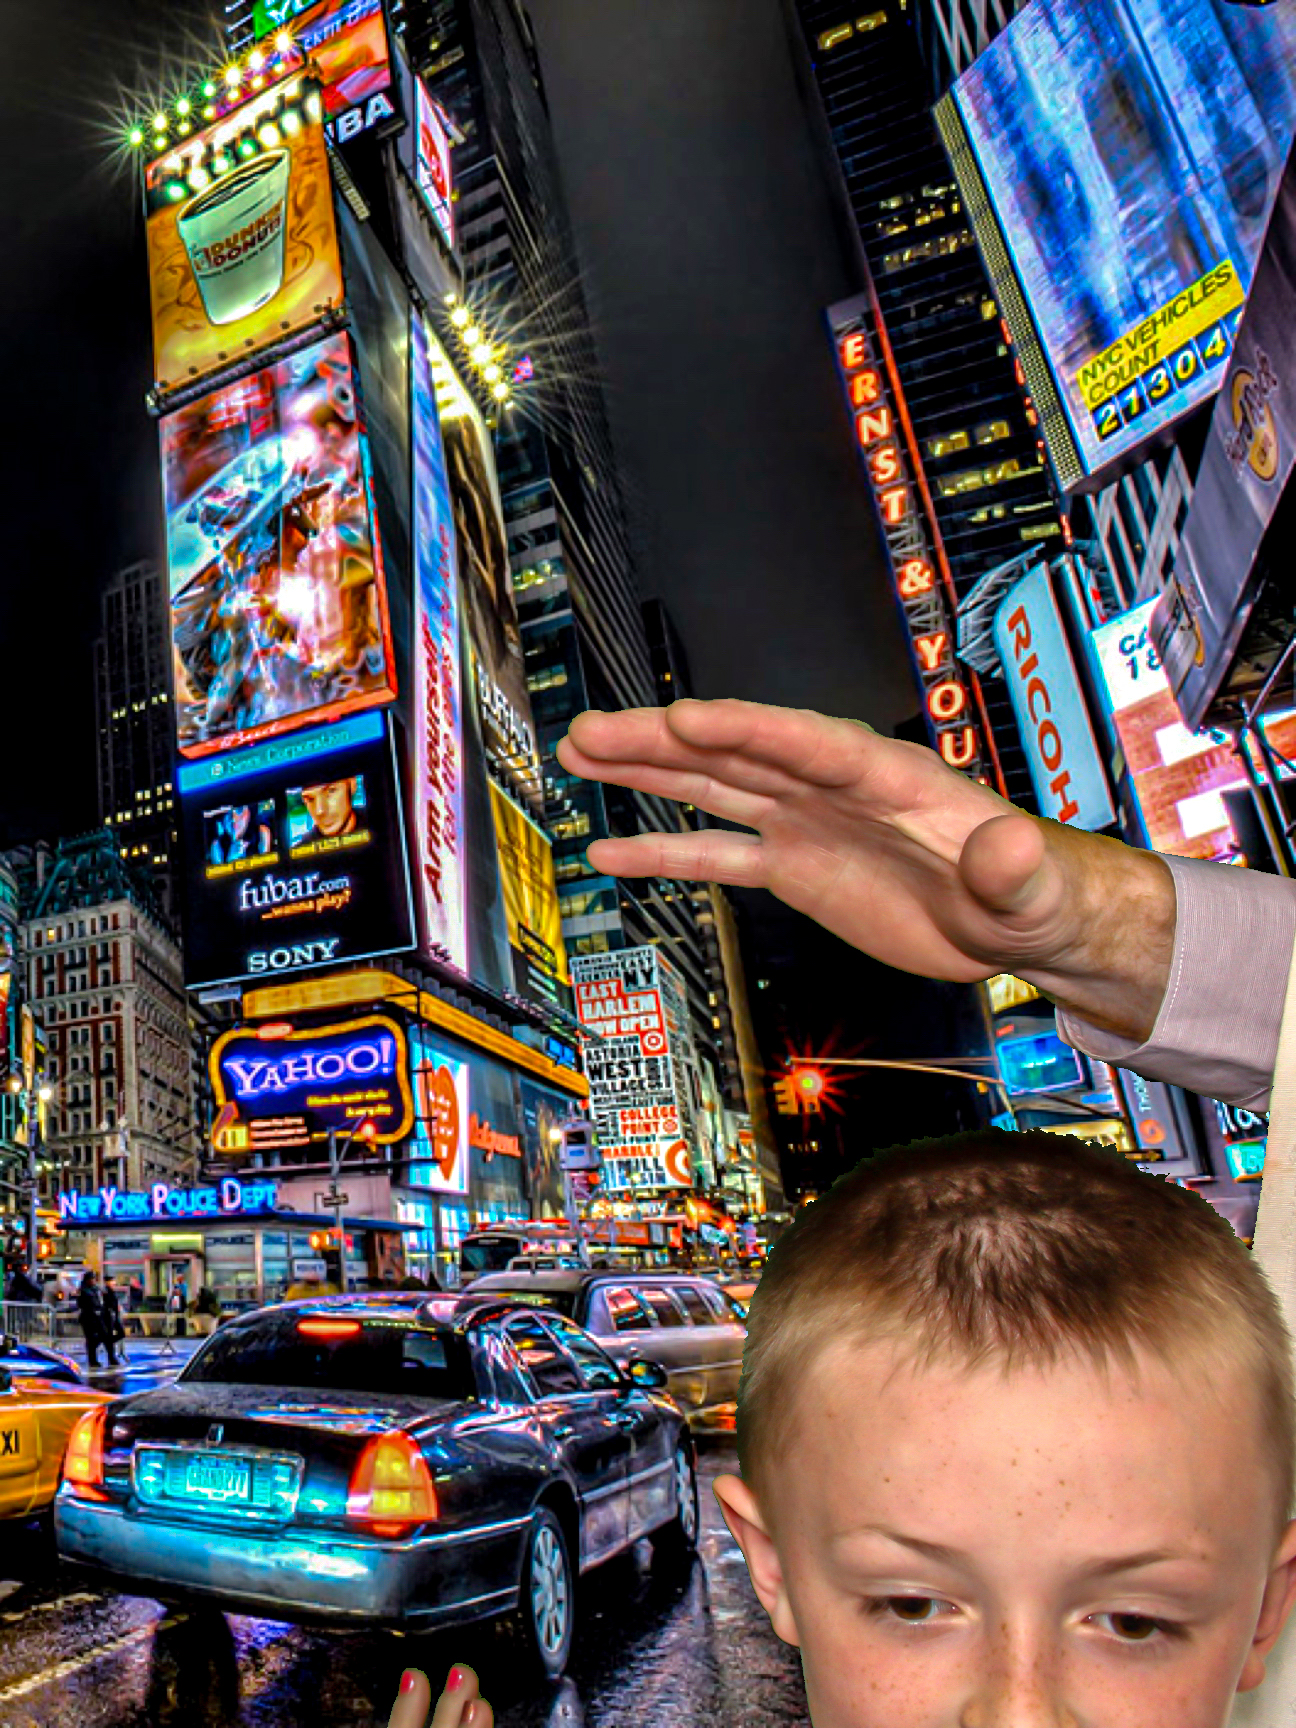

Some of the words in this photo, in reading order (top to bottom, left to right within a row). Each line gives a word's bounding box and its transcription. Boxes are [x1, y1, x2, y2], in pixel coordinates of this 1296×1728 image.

[1082, 343, 1124, 385] NYC
[1125, 263, 1232, 351] VEHICLES
[1089, 339, 1161, 402] COUNT
[842, 333, 906, 523] ERNST
[900, 559, 933, 596] &
[421, 611, 443, 795] yourself
[1007, 604, 1079, 823] RICOH
[424, 800, 443, 904] Arm
[247, 937, 340, 973] SONY
[582, 993, 657, 1019] HARLEM
[223, 1037, 392, 1096] YAHOO!
[152, 1184, 217, 1214] POLICE
[222, 1178, 277, 1211] DEPT
